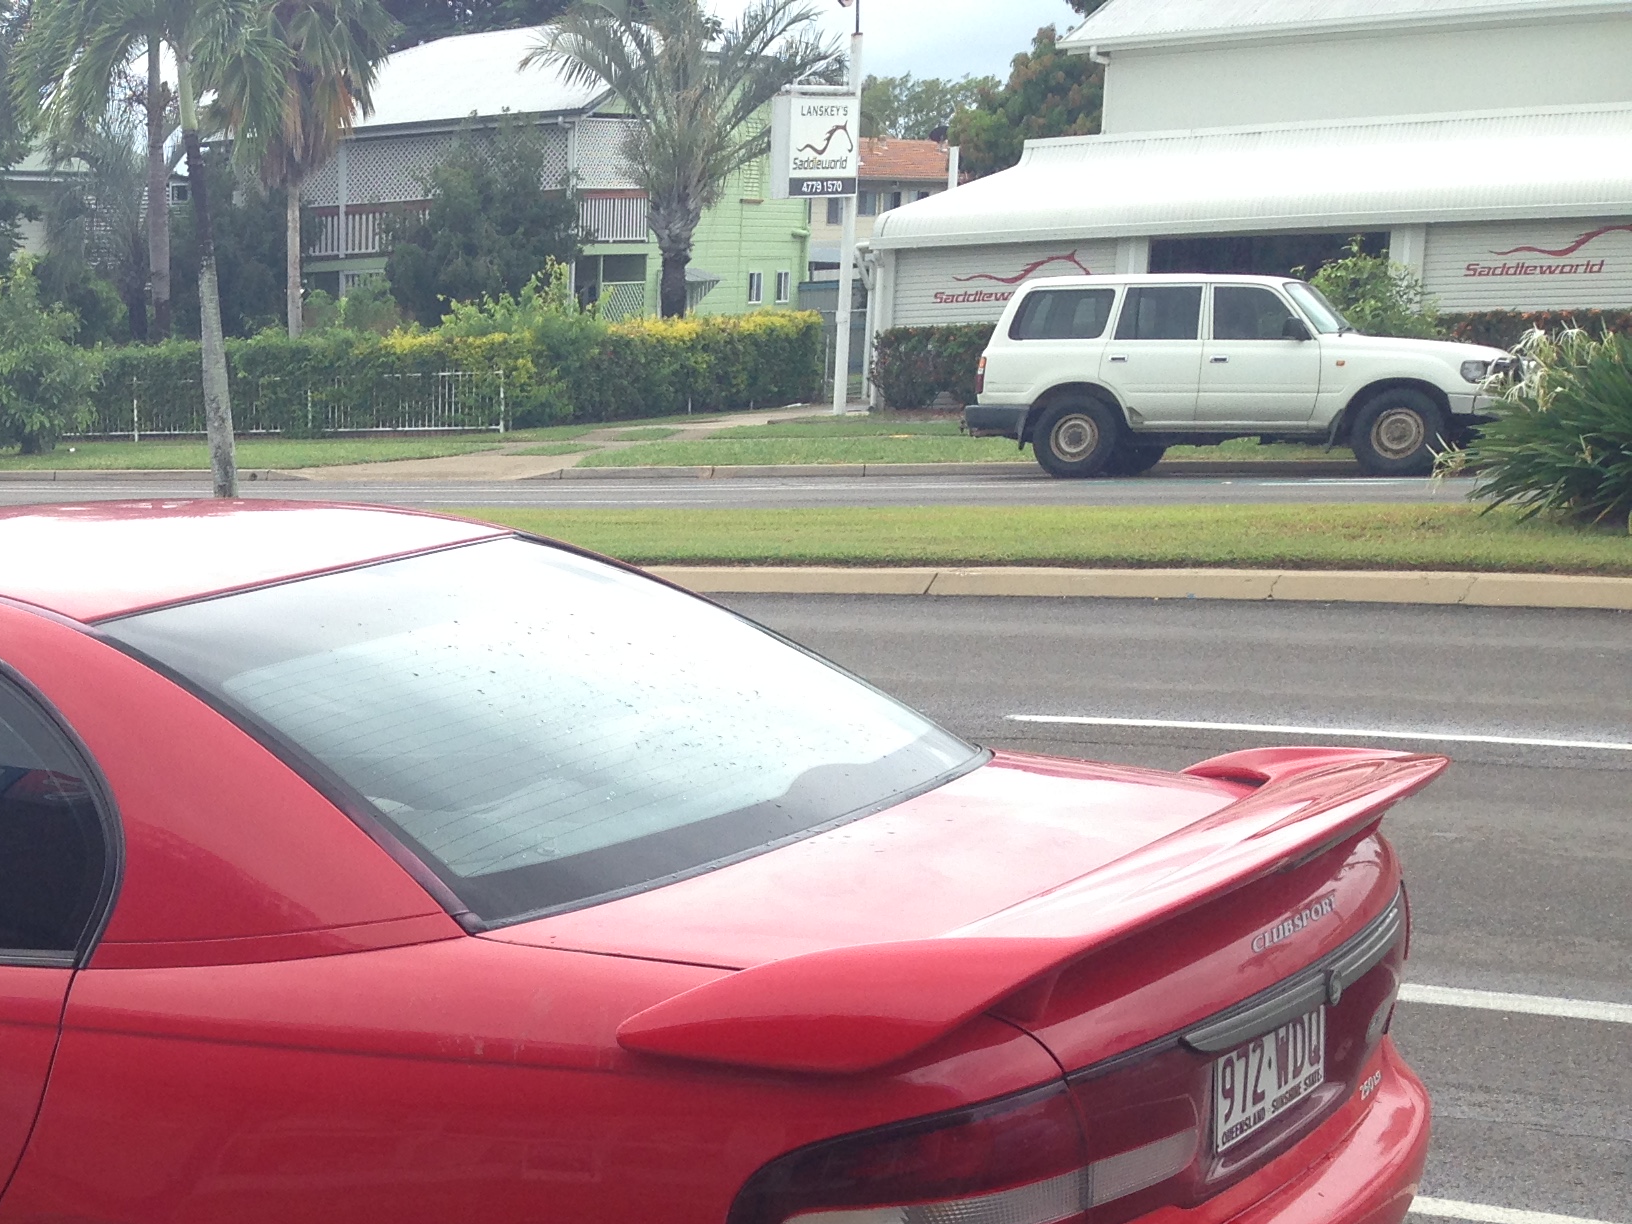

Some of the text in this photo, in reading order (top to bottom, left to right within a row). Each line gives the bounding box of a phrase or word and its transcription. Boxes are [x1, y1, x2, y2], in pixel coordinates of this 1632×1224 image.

[801, 105, 848, 116] LANSKEY'S
[792, 156, 848, 170] Saddleworld
[802, 181, 843, 192] 4779 1570
[1463, 259, 1605, 277] Saddleworld
[932, 290, 1015, 304] Saddlew
[1251, 892, 1337, 953] CLUBSPORT
[1222, 1107, 1265, 1146] QUEENSLAND
